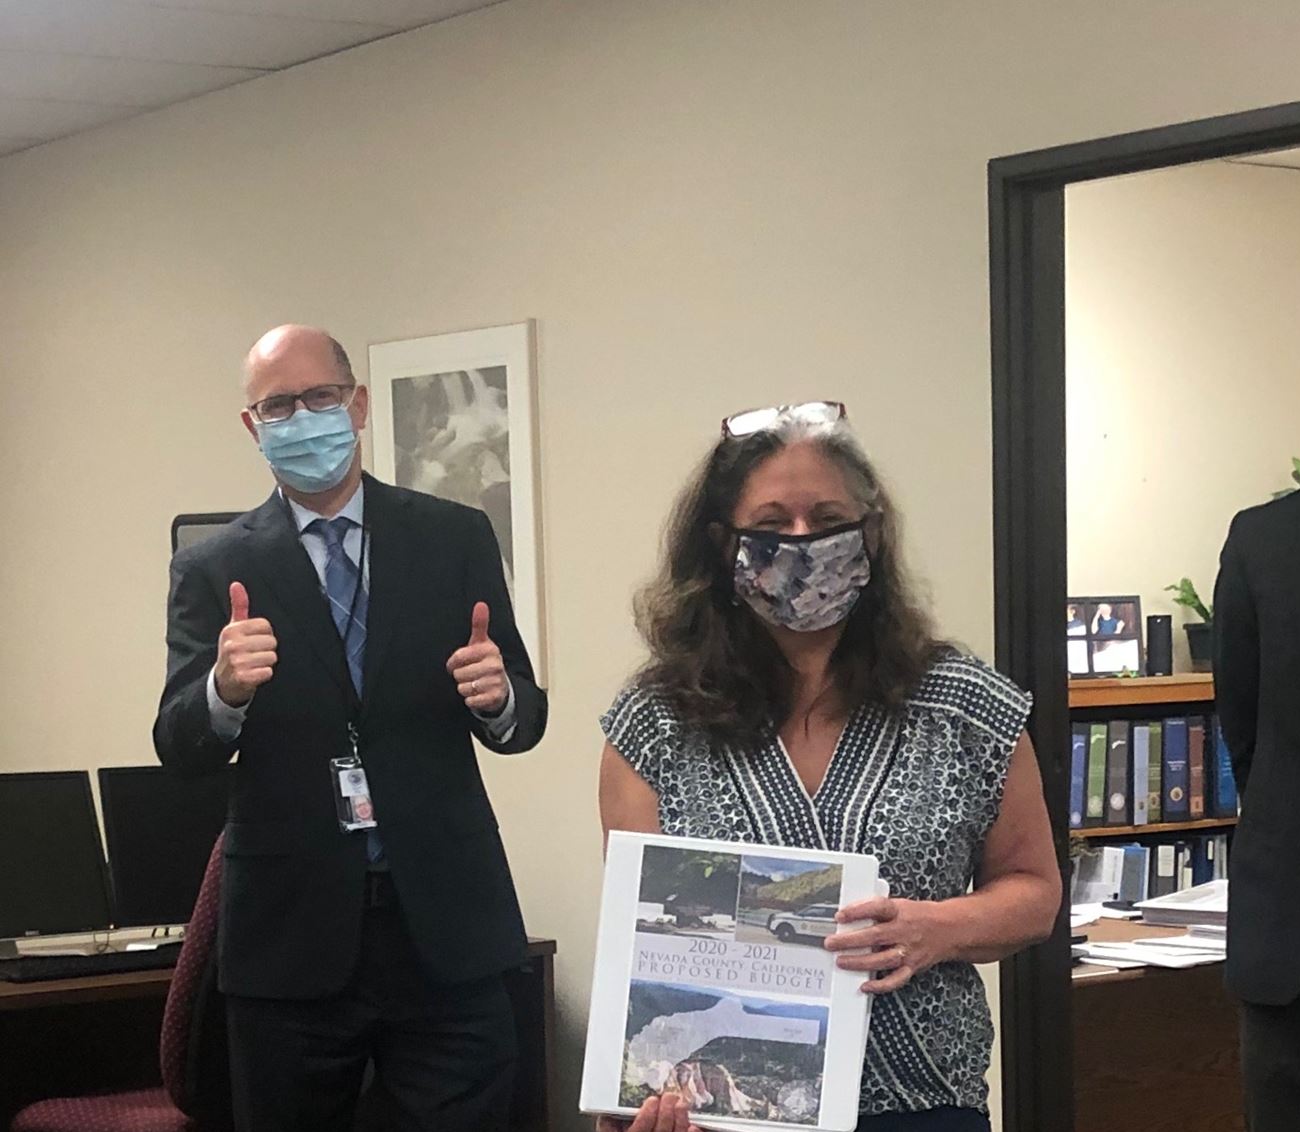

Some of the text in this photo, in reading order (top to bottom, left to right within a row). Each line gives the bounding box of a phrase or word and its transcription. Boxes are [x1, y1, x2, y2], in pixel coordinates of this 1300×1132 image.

[688, 939, 728, 955] 2020
[743, 944, 777, 961] 2021
[638, 960, 825, 990] PROPOSED BUDGET
